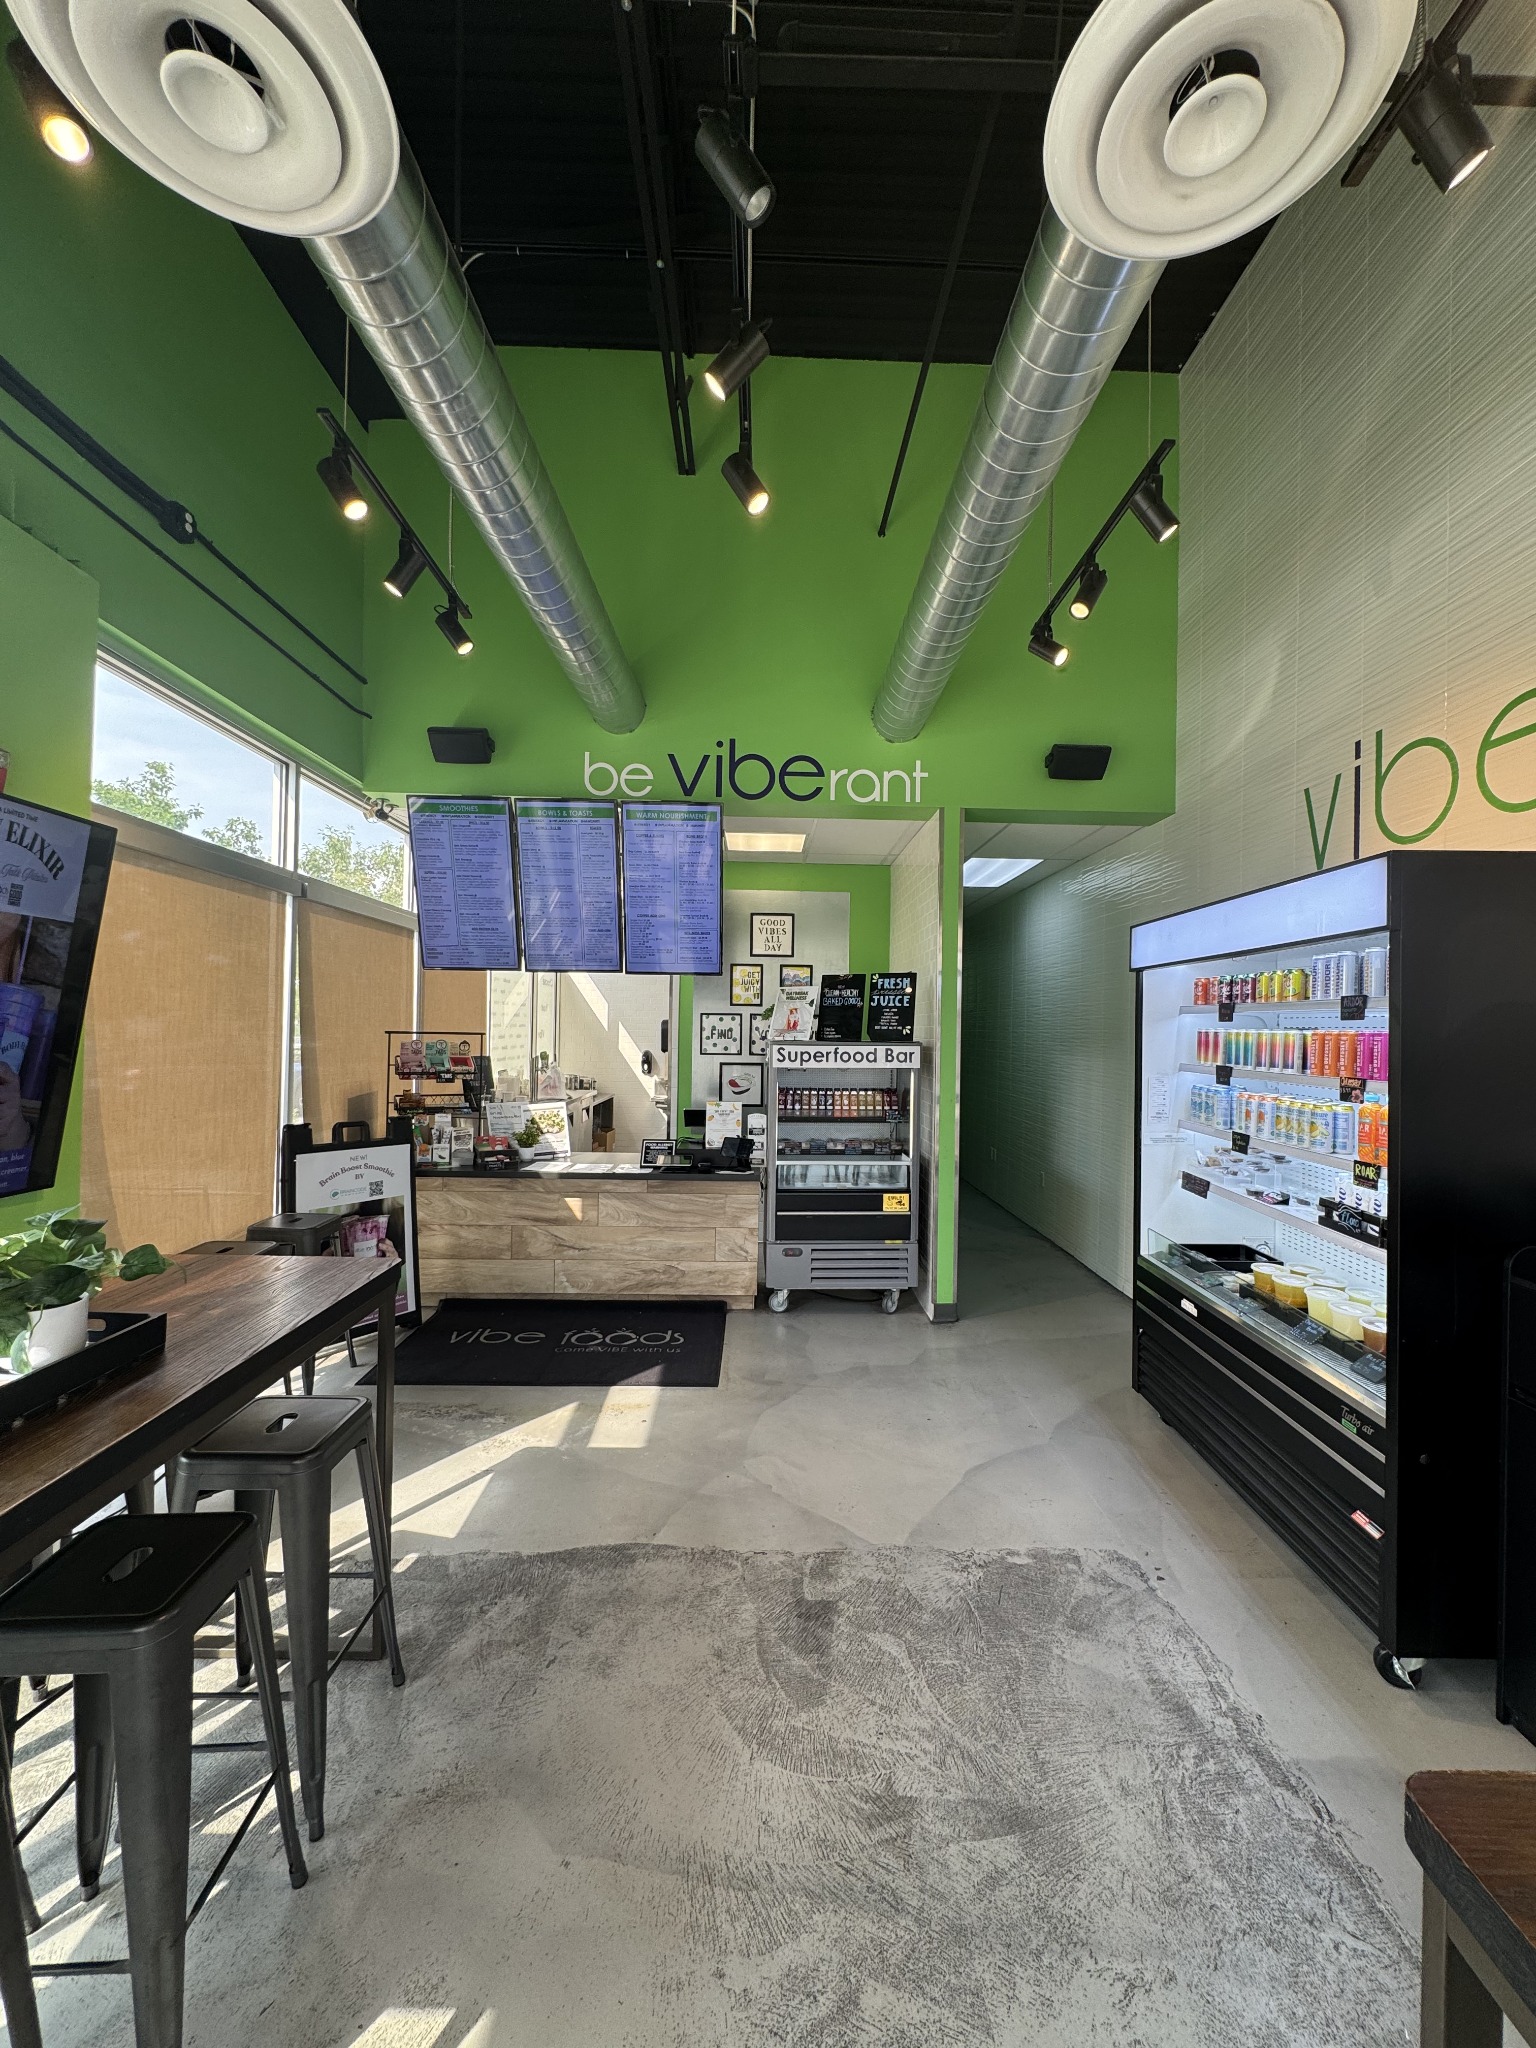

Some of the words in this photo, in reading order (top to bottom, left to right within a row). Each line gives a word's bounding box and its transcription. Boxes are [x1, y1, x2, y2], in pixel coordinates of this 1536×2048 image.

[584, 751, 654, 797] be
[667, 738, 929, 803] viberant
[3, 807, 26, 819] LIMITED
[537, 809, 561, 817] BOWLS
[659, 812, 708, 820] NOURISHMENT
[5, 820, 65, 881] ELIXIR
[760, 918, 786, 927] GOOD
[758, 927, 787, 936] VIBES
[764, 935, 782, 943] ALL
[764, 943, 782, 952] DAY
[747, 971, 760, 979] GET
[740, 978, 760, 986] JUICY
[877, 977, 911, 989] FRESH
[744, 985, 760, 993] WITH
[822, 997, 844, 1006] BAKED
[843, 997, 861, 1006] GOODS
[870, 995, 911, 1007] JUICE
[1343, 996, 1364, 1008] ARDOR
[710, 1028, 733, 1040] FIND
[776, 1046, 878, 1067] Superfood
[884, 1047, 915, 1063] Bar
[349, 1154, 368, 1162] NEW!
[318, 1170, 341, 1188] Brain
[340, 1164, 363, 1175] Boost
[363, 1162, 396, 1178] Smoothie
[1355, 1163, 1377, 1181] ROAR
[449, 1328, 546, 1344] vibe
[559, 1327, 685, 1346] foods
[1340, 1405, 1361, 1428] Turbo
[1361, 1424, 1375, 1436] air
